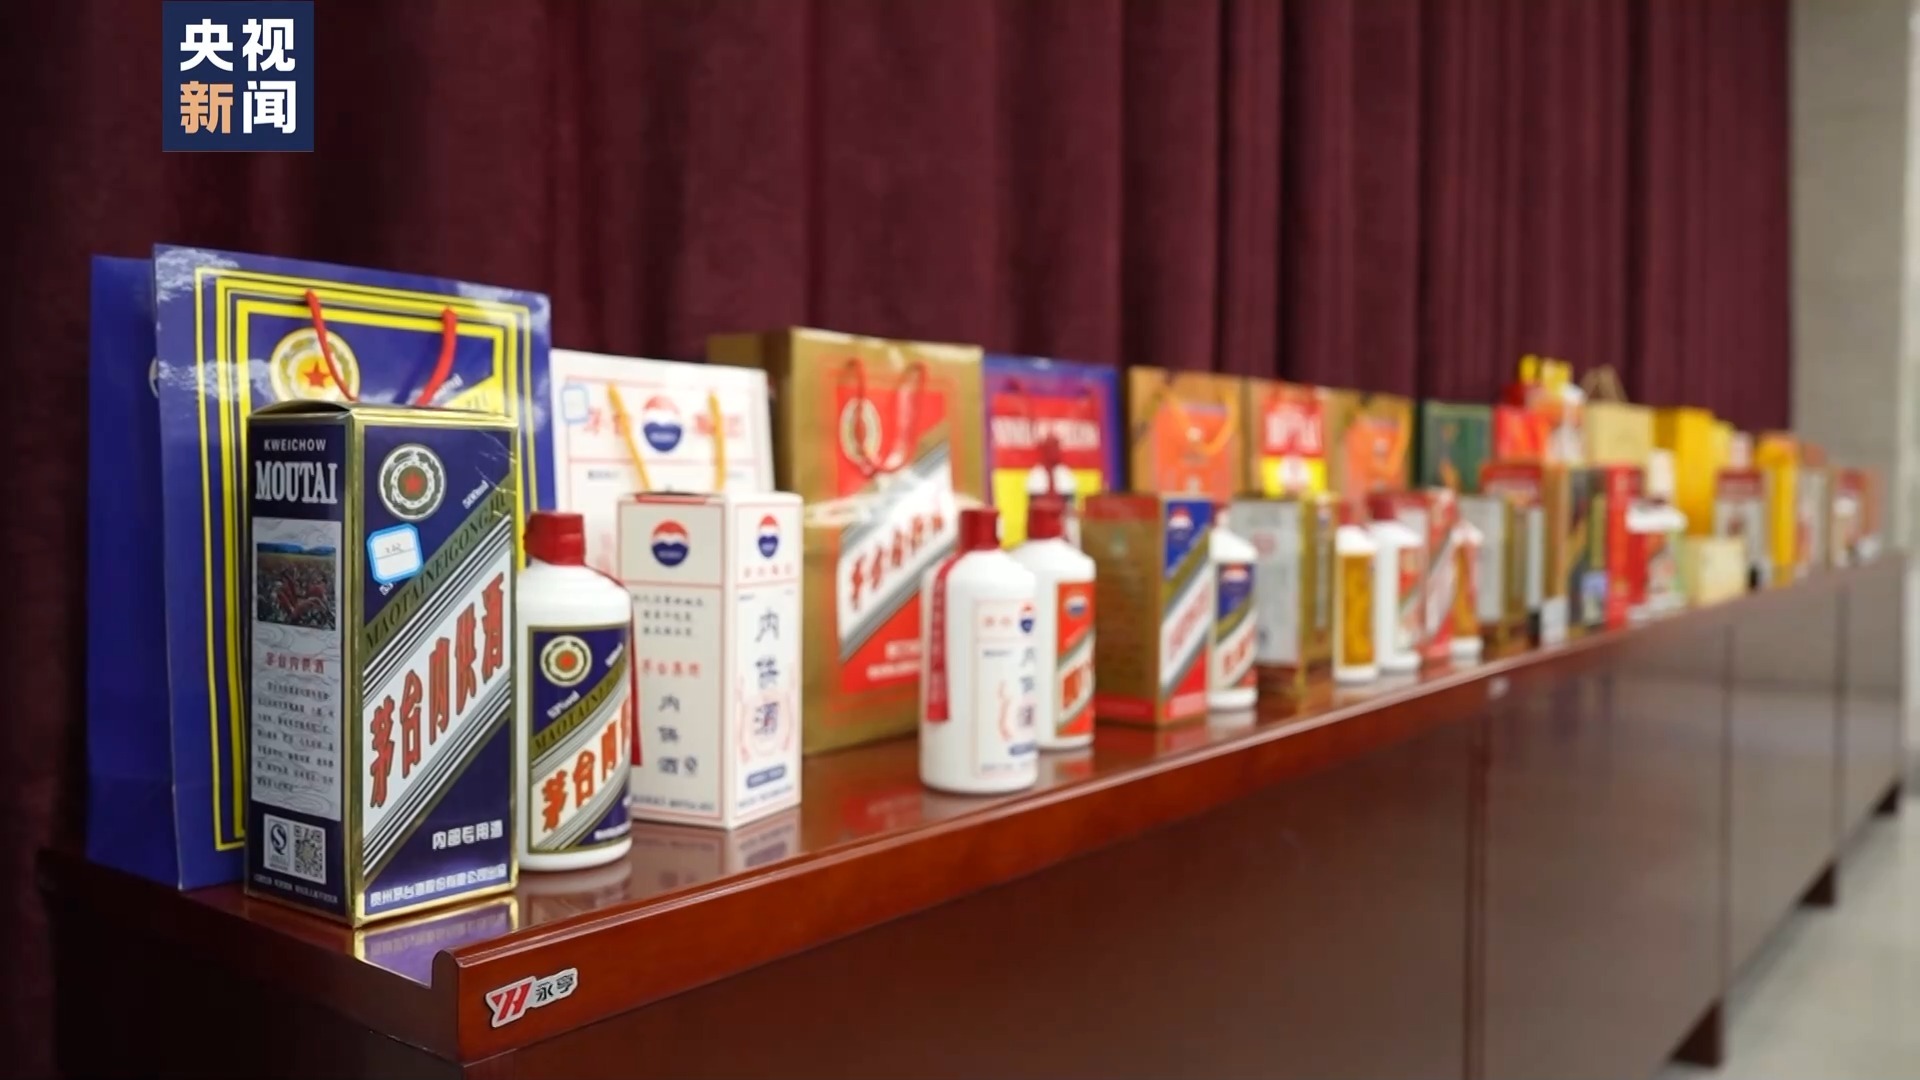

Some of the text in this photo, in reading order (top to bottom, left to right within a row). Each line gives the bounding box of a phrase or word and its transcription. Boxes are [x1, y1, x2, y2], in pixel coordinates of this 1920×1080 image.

[264, 438, 327, 451] KWEICHOW
[255, 461, 338, 504] MOUTAI
[370, 571, 504, 809] 茅台内供酒
[432, 819, 503, 851] 内部专用酒
